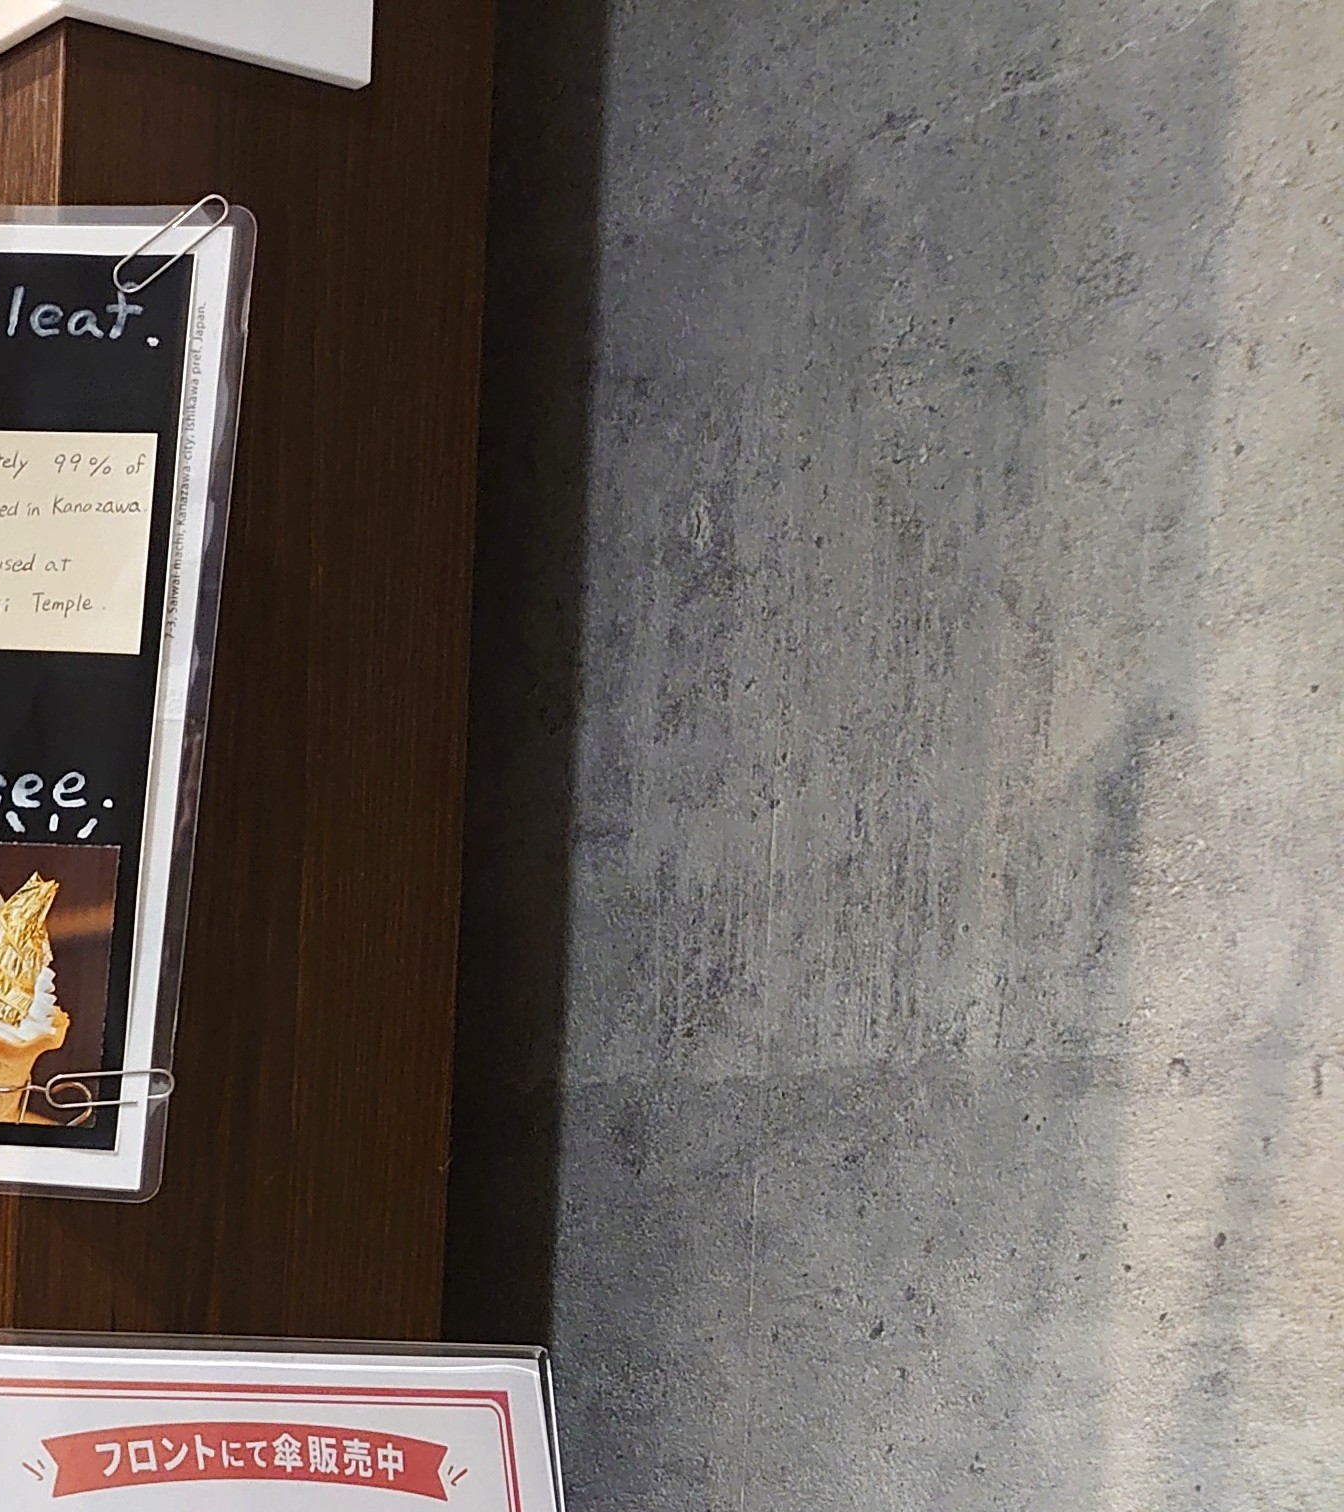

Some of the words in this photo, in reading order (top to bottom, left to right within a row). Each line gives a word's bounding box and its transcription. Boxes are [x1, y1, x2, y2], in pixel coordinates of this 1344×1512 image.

[185, 378, 200, 431] Ishikawa
[126, 454, 146, 474] of
[27, 502, 40, 517] in
[45, 558, 71, 571] at
[94, 1432, 406, 1482] フロントにて傘販売中
